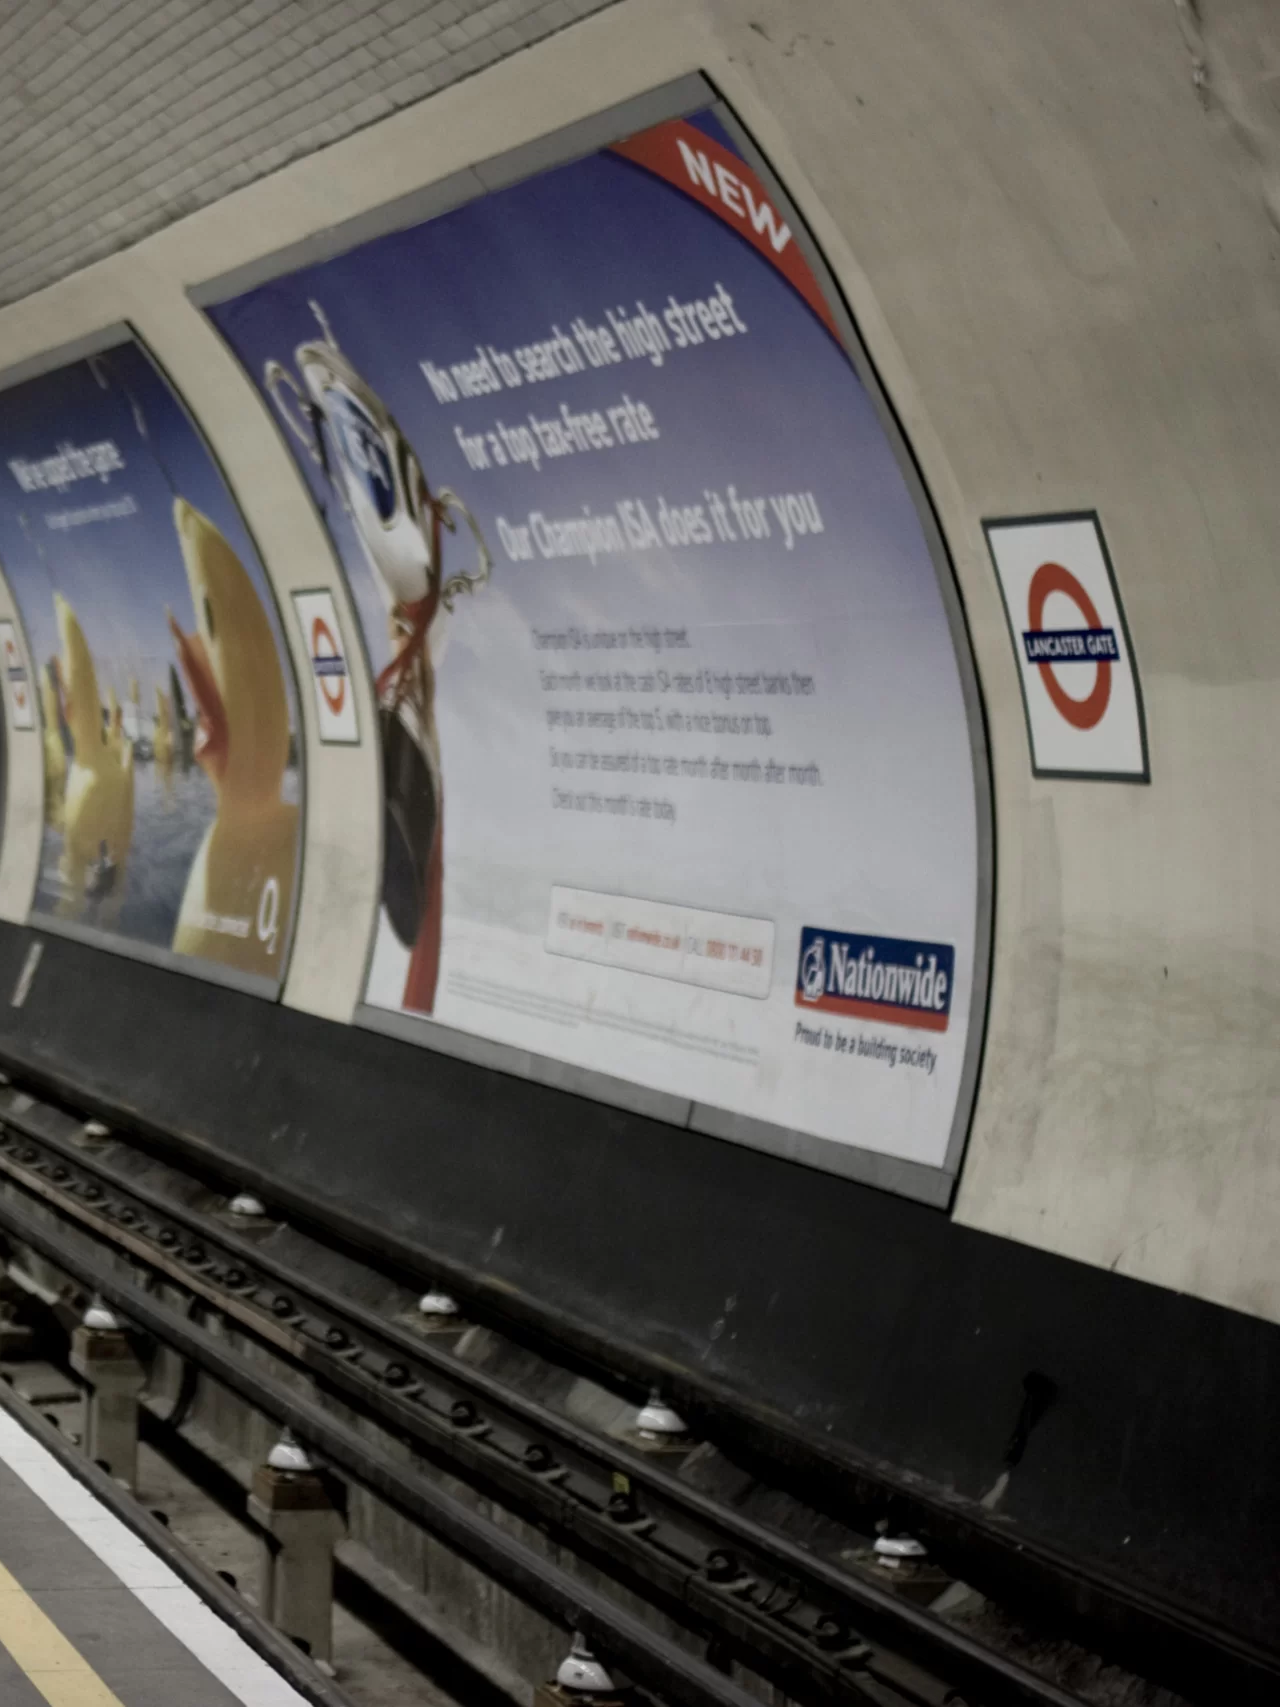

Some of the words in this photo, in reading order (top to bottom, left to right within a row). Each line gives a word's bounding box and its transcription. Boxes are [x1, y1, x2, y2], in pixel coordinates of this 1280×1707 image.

[676, 138, 792, 253] NEW
[419, 359, 459, 404] No
[450, 345, 502, 398] need
[487, 345, 523, 388] to
[514, 325, 586, 383] search
[570, 317, 622, 369] the
[604, 301, 673, 367] high
[663, 281, 748, 348] street
[496, 420, 541, 472] top
[528, 402, 614, 458] tax-free
[606, 393, 660, 444] rate
[454, 424, 491, 471] for
[486, 432, 508, 467] a
[496, 515, 535, 562] Our
[529, 504, 625, 566] Champion
[616, 498, 663, 551] ISA
[655, 494, 714, 546] does
[703, 489, 738, 541] it
[727, 483, 772, 540] for
[769, 491, 824, 550] you
[1026, 635, 1087, 657] LANCASTER
[1087, 634, 1116, 656] GATE
[827, 942, 947, 1010] Nationwide
[795, 1020, 822, 1047] Proud
[823, 1028, 833, 1050] to
[835, 1031, 848, 1053] be
[849, 1036, 856, 1054] a
[857, 1033, 897, 1069] building
[899, 1046, 937, 1076] society
